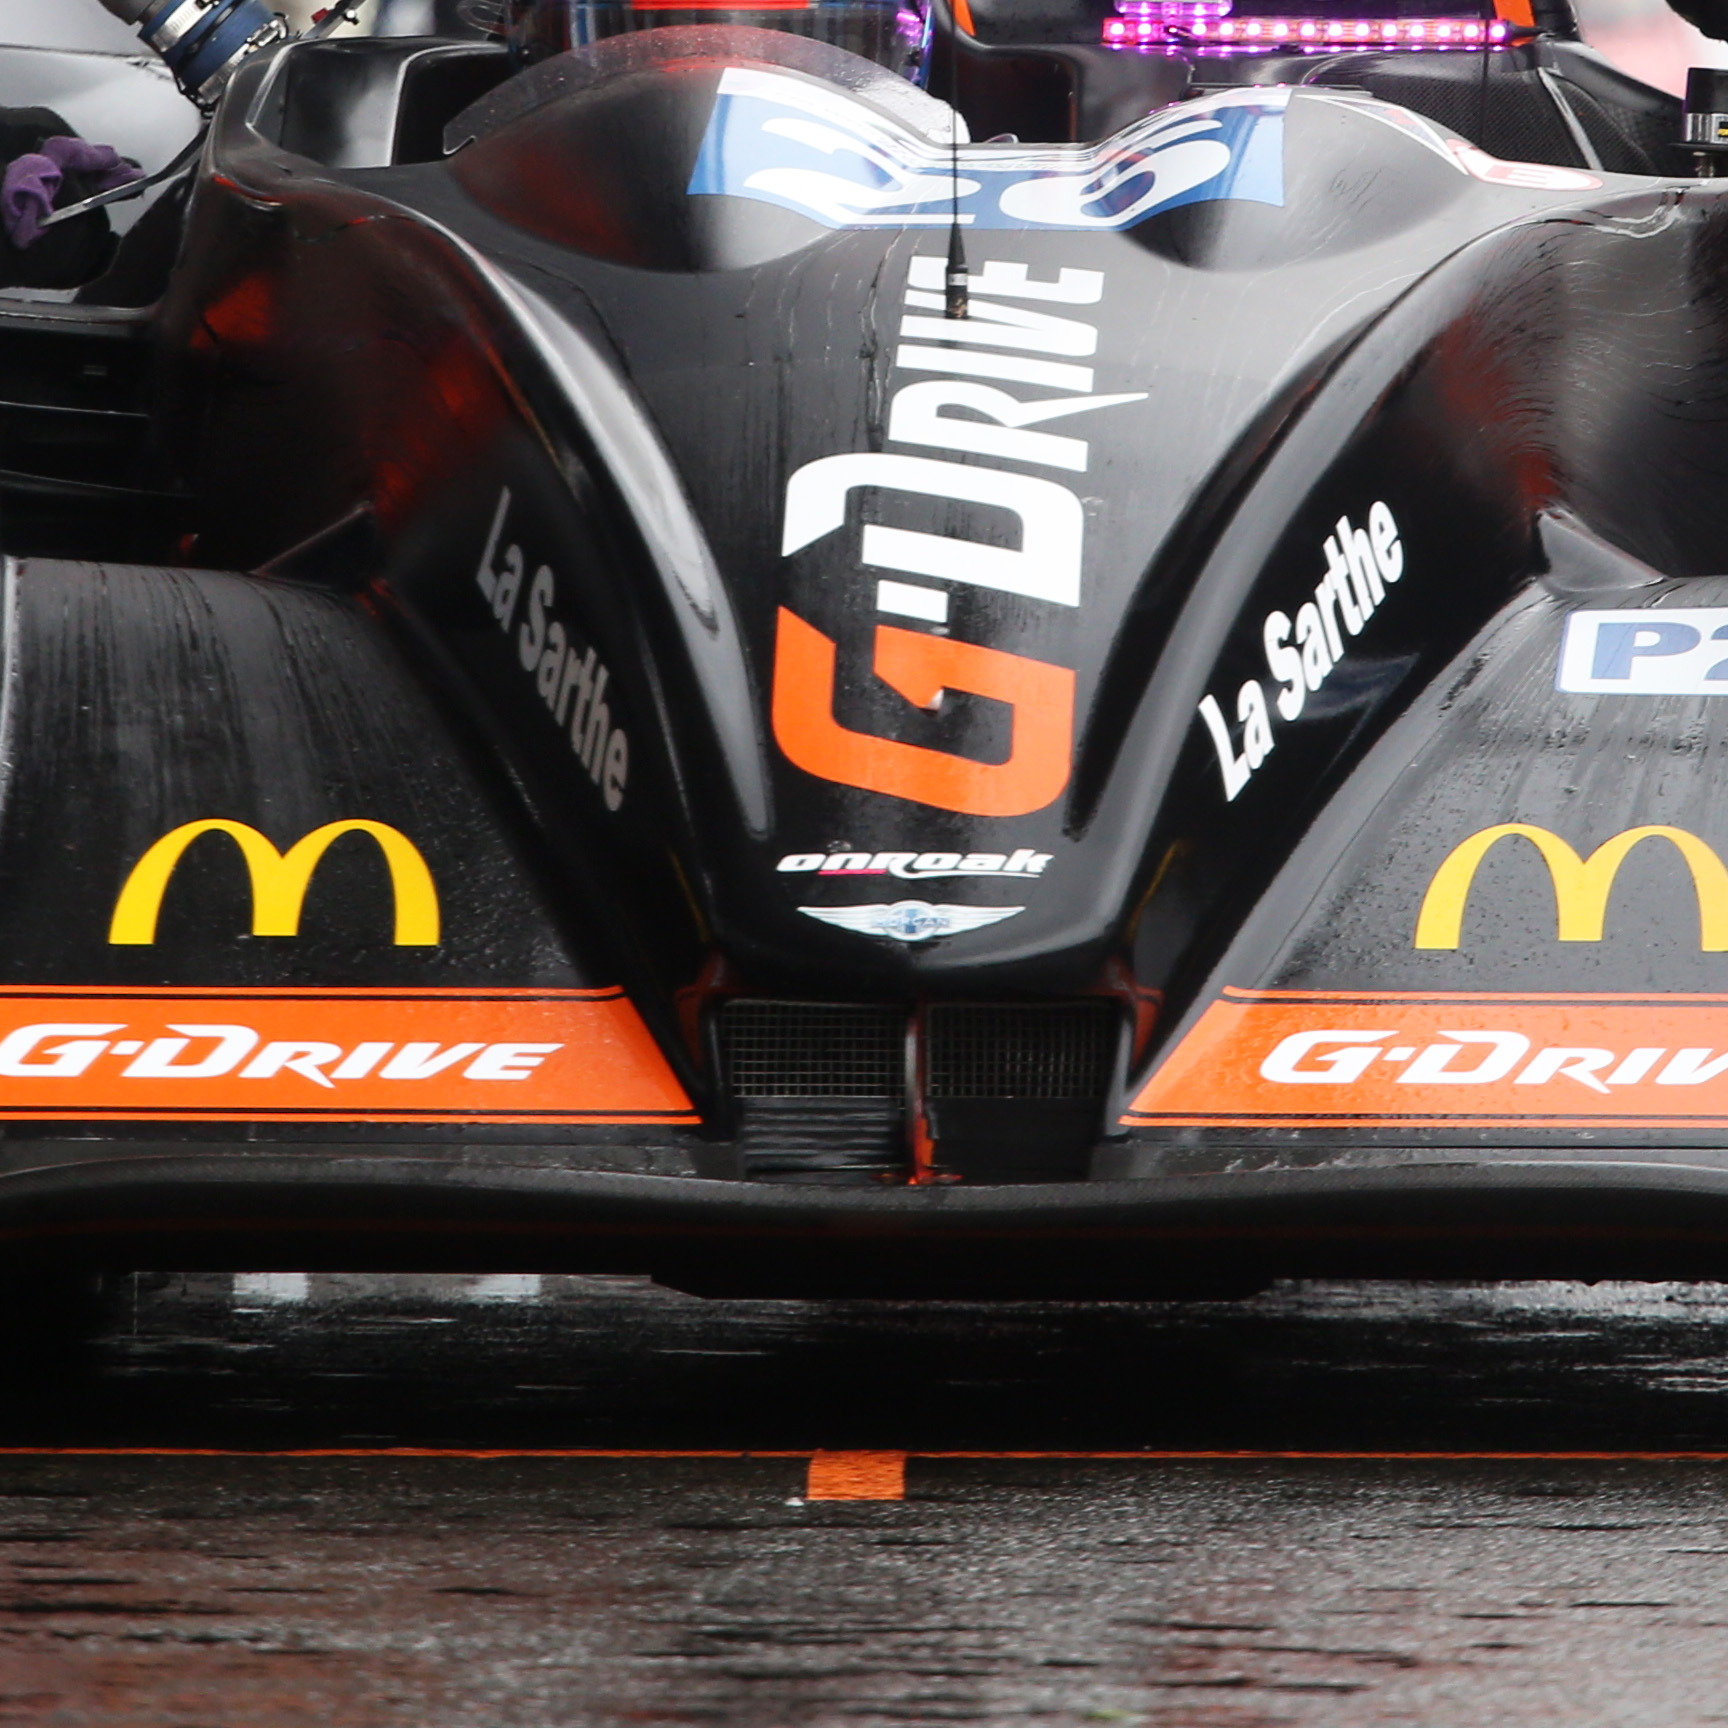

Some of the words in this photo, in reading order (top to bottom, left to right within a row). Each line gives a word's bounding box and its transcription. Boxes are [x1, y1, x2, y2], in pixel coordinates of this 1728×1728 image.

[476, 485, 523, 633] La
[519, 564, 628, 812] Sarthe
[1198, 693, 1275, 802] La
[1264, 501, 1404, 722] Sarthe
